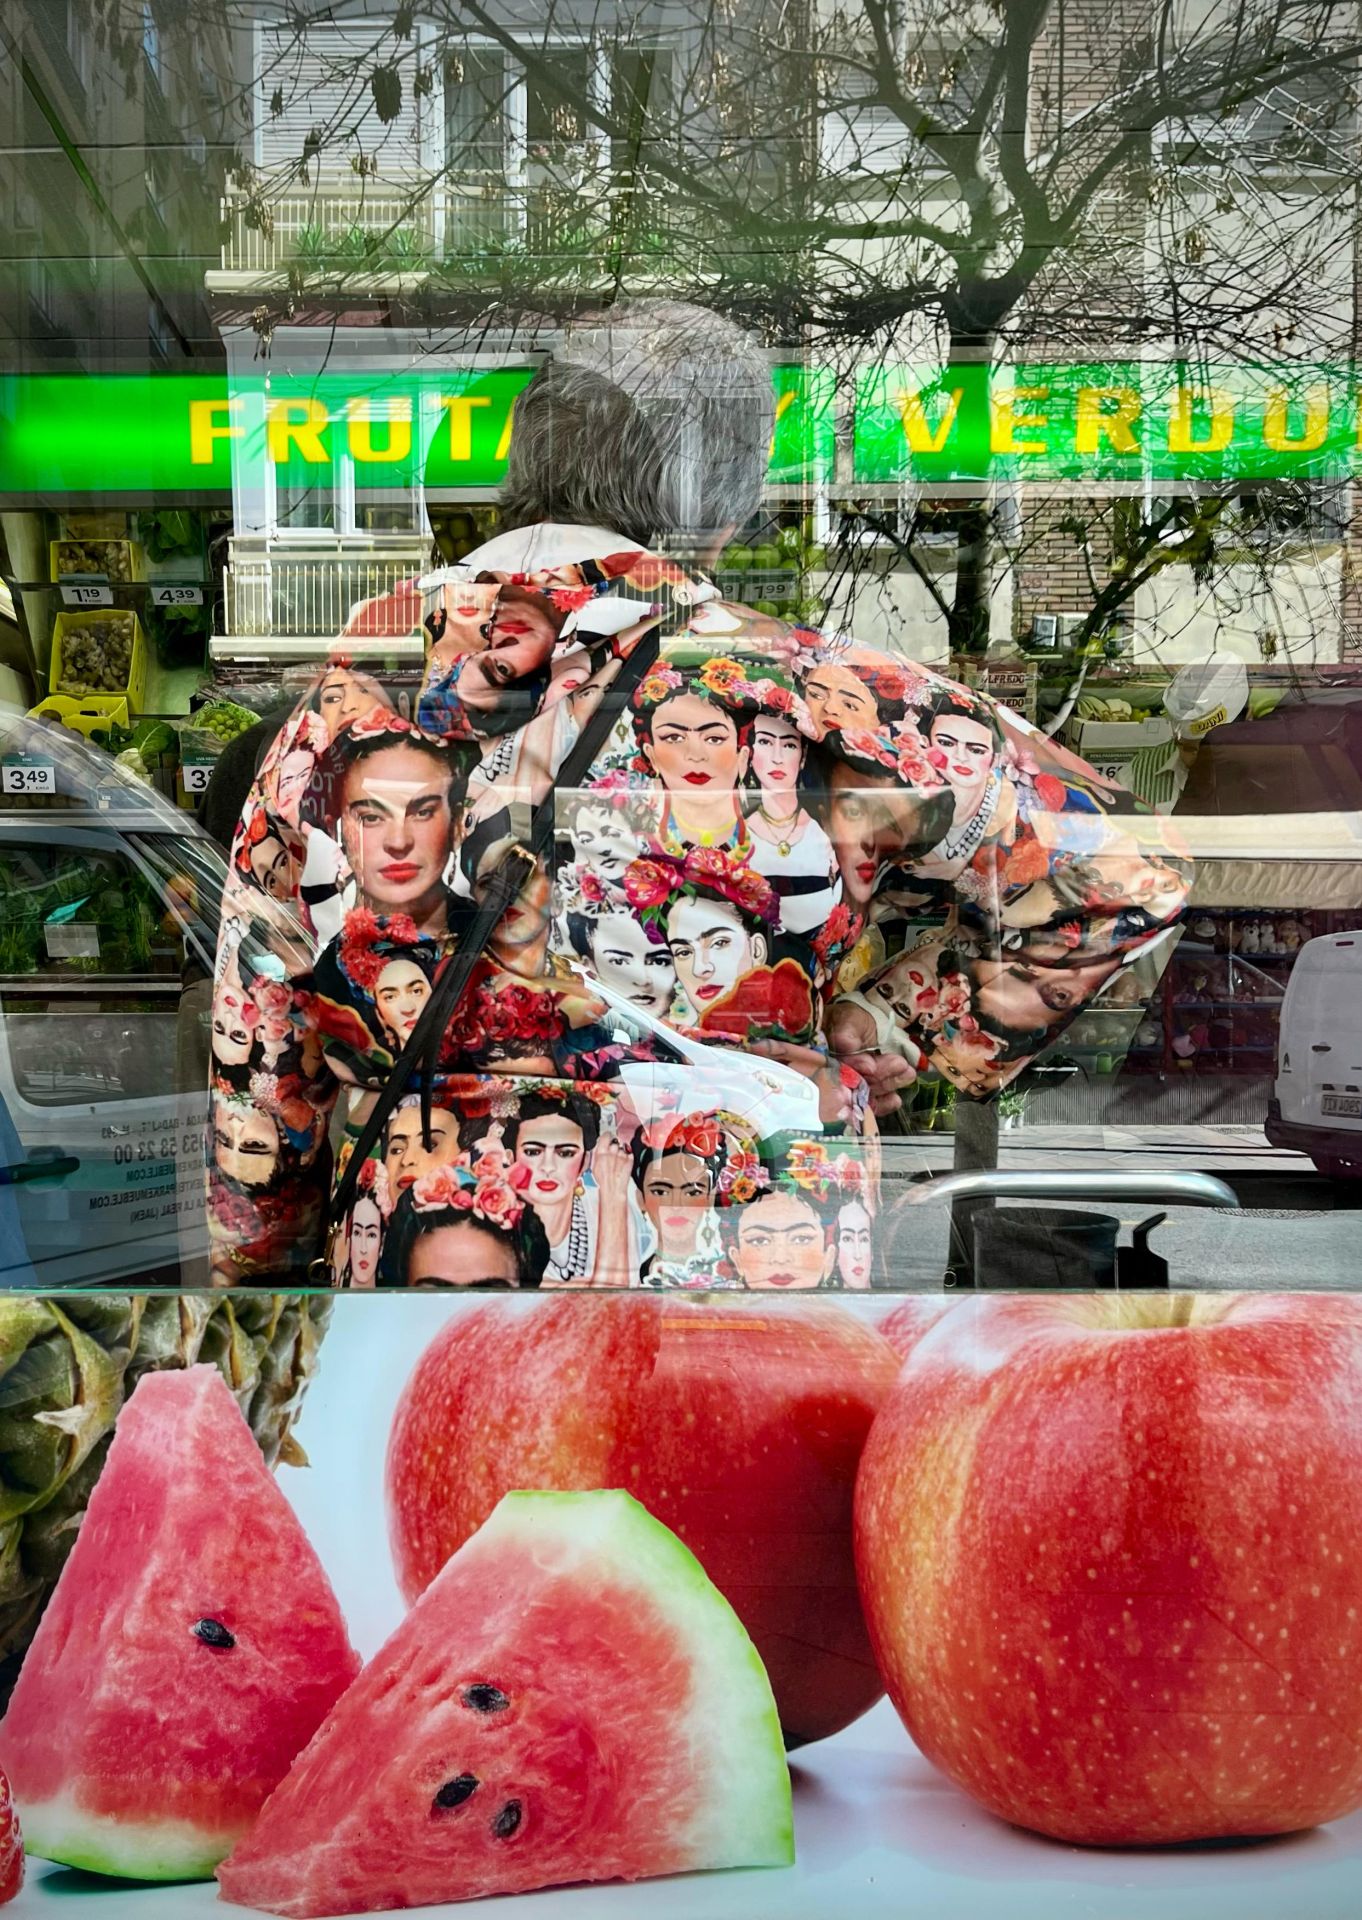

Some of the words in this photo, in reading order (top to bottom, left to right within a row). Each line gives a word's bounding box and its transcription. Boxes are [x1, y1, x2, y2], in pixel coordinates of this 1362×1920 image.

[189, 396, 514, 464] FRUT
[899, 387, 1362, 455] VERDU
[159, 589, 194, 604] 4,39
[999, 698, 1025, 708] REDO
[10, 770, 48, 790] 3,49
